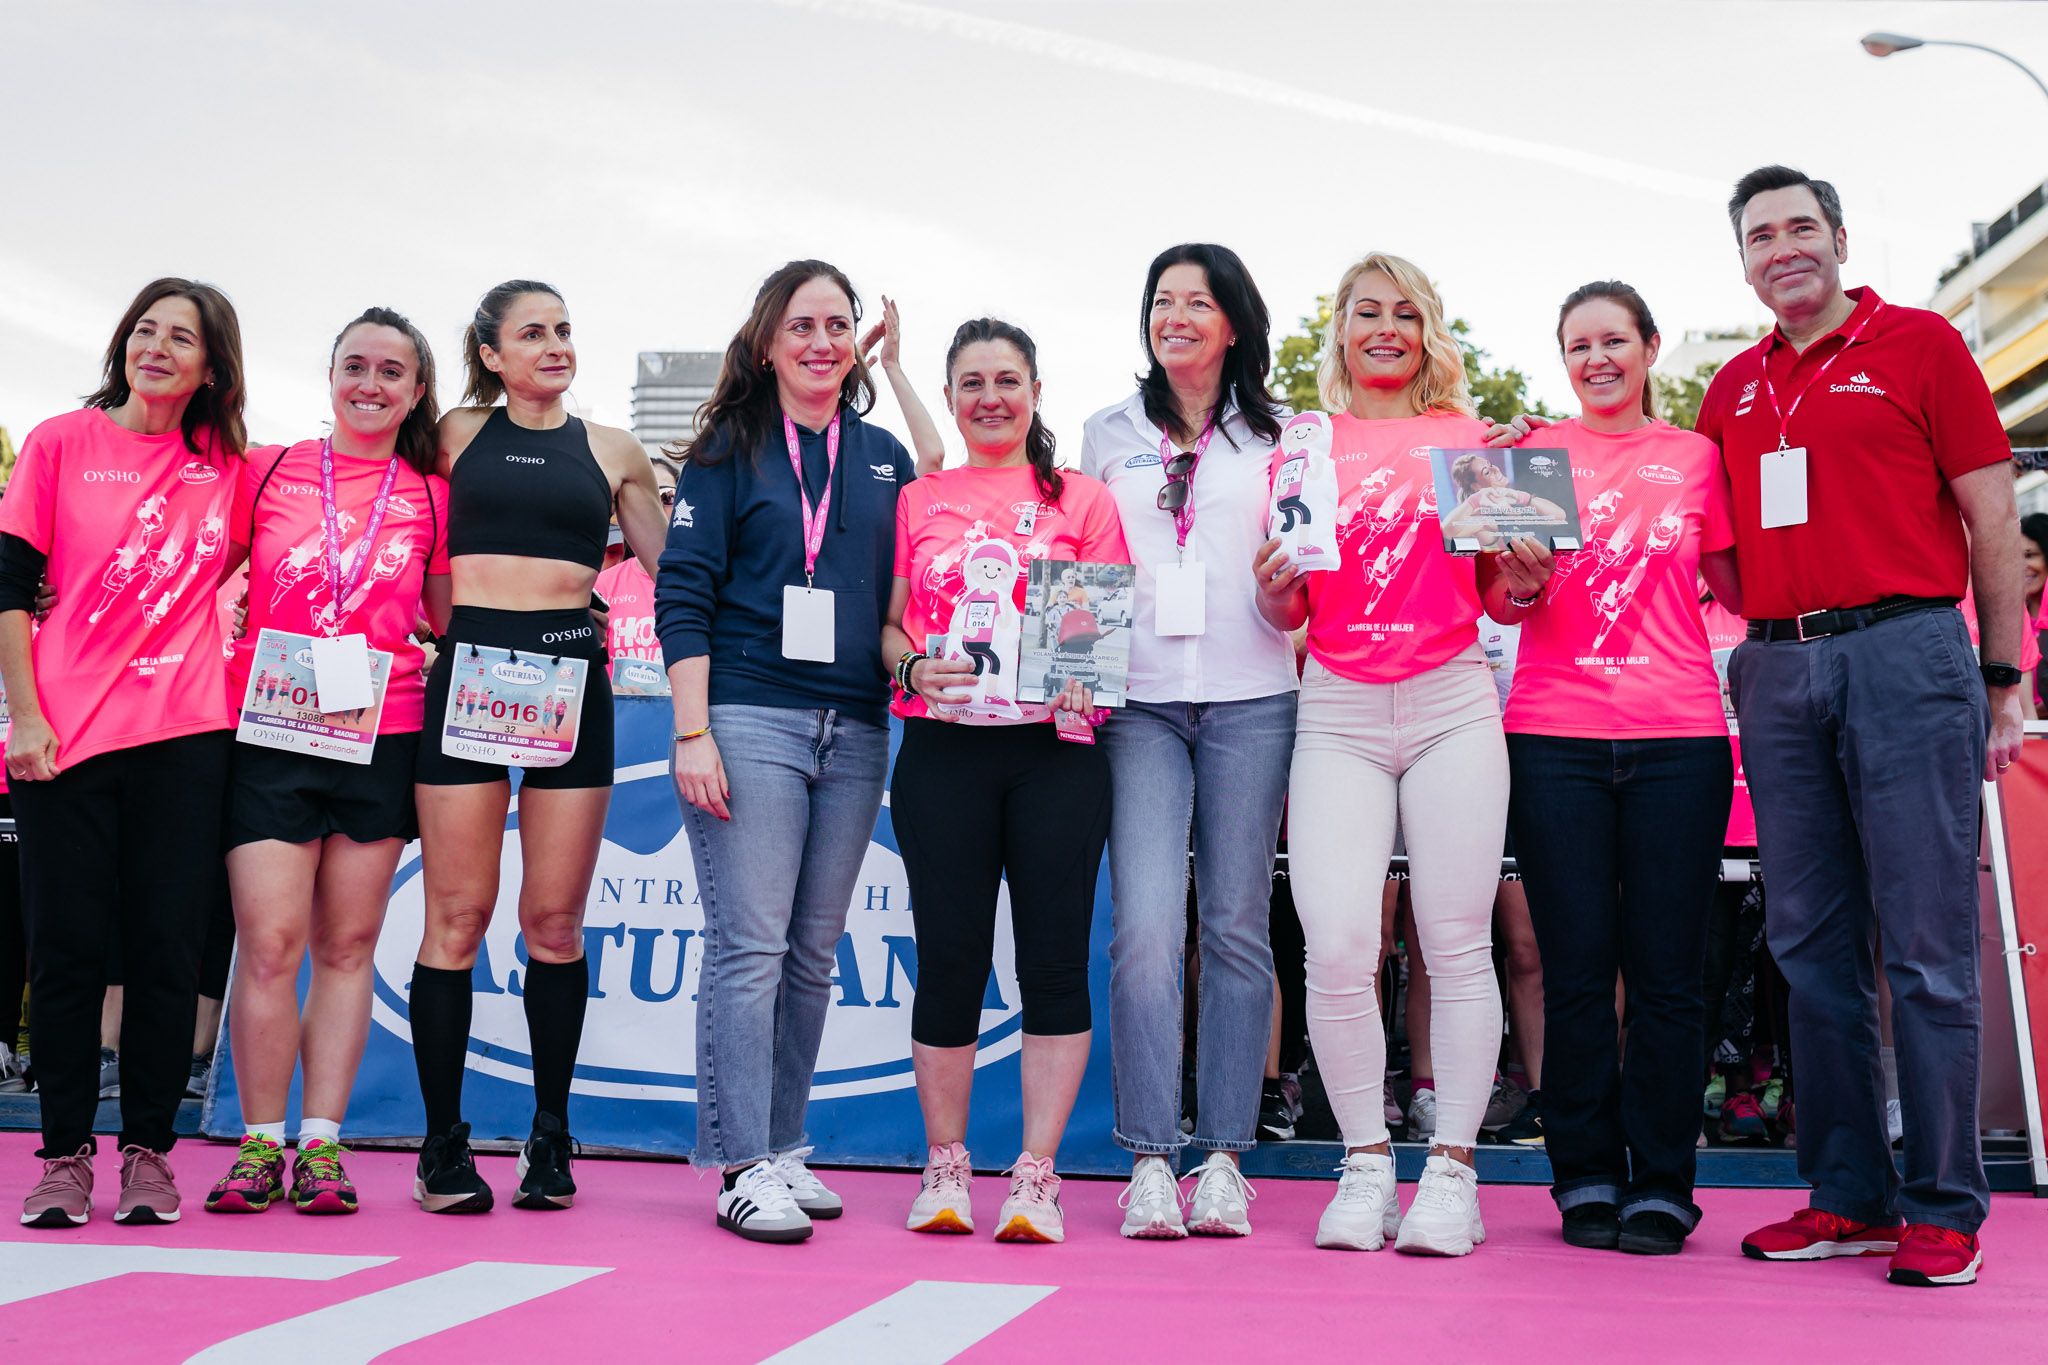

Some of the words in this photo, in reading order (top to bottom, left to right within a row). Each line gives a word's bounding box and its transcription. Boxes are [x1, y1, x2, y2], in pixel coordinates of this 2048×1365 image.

[1829, 383, 1886, 397] Santander
[505, 455, 545, 465] OYSHO
[1337, 452, 1368, 464] SHO
[83, 470, 141, 483] OYSHO
[1641, 469, 1681, 482] ASTURIANA
[387, 502, 414, 516] TURIANA
[928, 502, 971, 516] OYSO
[1381, 623, 1390, 631] LA
[1390, 623, 1414, 632] MUJER
[542, 626, 593, 644] OYSHO
[1708, 634, 1738, 643] YSHO
[149, 656, 159, 665] LA
[1574, 657, 1605, 665] CARRERA
[1605, 657, 1615, 665] DE
[1616, 657, 1625, 665] LA
[1626, 656, 1650, 665] MUJER
[495, 667, 543, 681] ASTURIANA
[1604, 666, 1621, 675] 2024
[292, 687, 319, 709] 01
[296, 711, 325, 724] 13086
[490, 700, 539, 722] 016
[257, 715, 287, 727] CARRERA
[288, 720, 297, 729] DE
[297, 722, 307, 731] LA
[307, 724, 330, 736] MUJER
[333, 728, 360, 740] MADRID
[504, 725, 516, 734] 32
[253, 728, 295, 743] OYSHO
[459, 729, 487, 740] CARRERA
[488, 733, 497, 741] DE
[498, 734, 507, 742] LA
[507, 736, 529, 745] MUJER
[534, 739, 559, 749] MADRID
[320, 741, 359, 755] Santander
[456, 742, 496, 756] OYSHO
[521, 753, 559, 763] Santander
